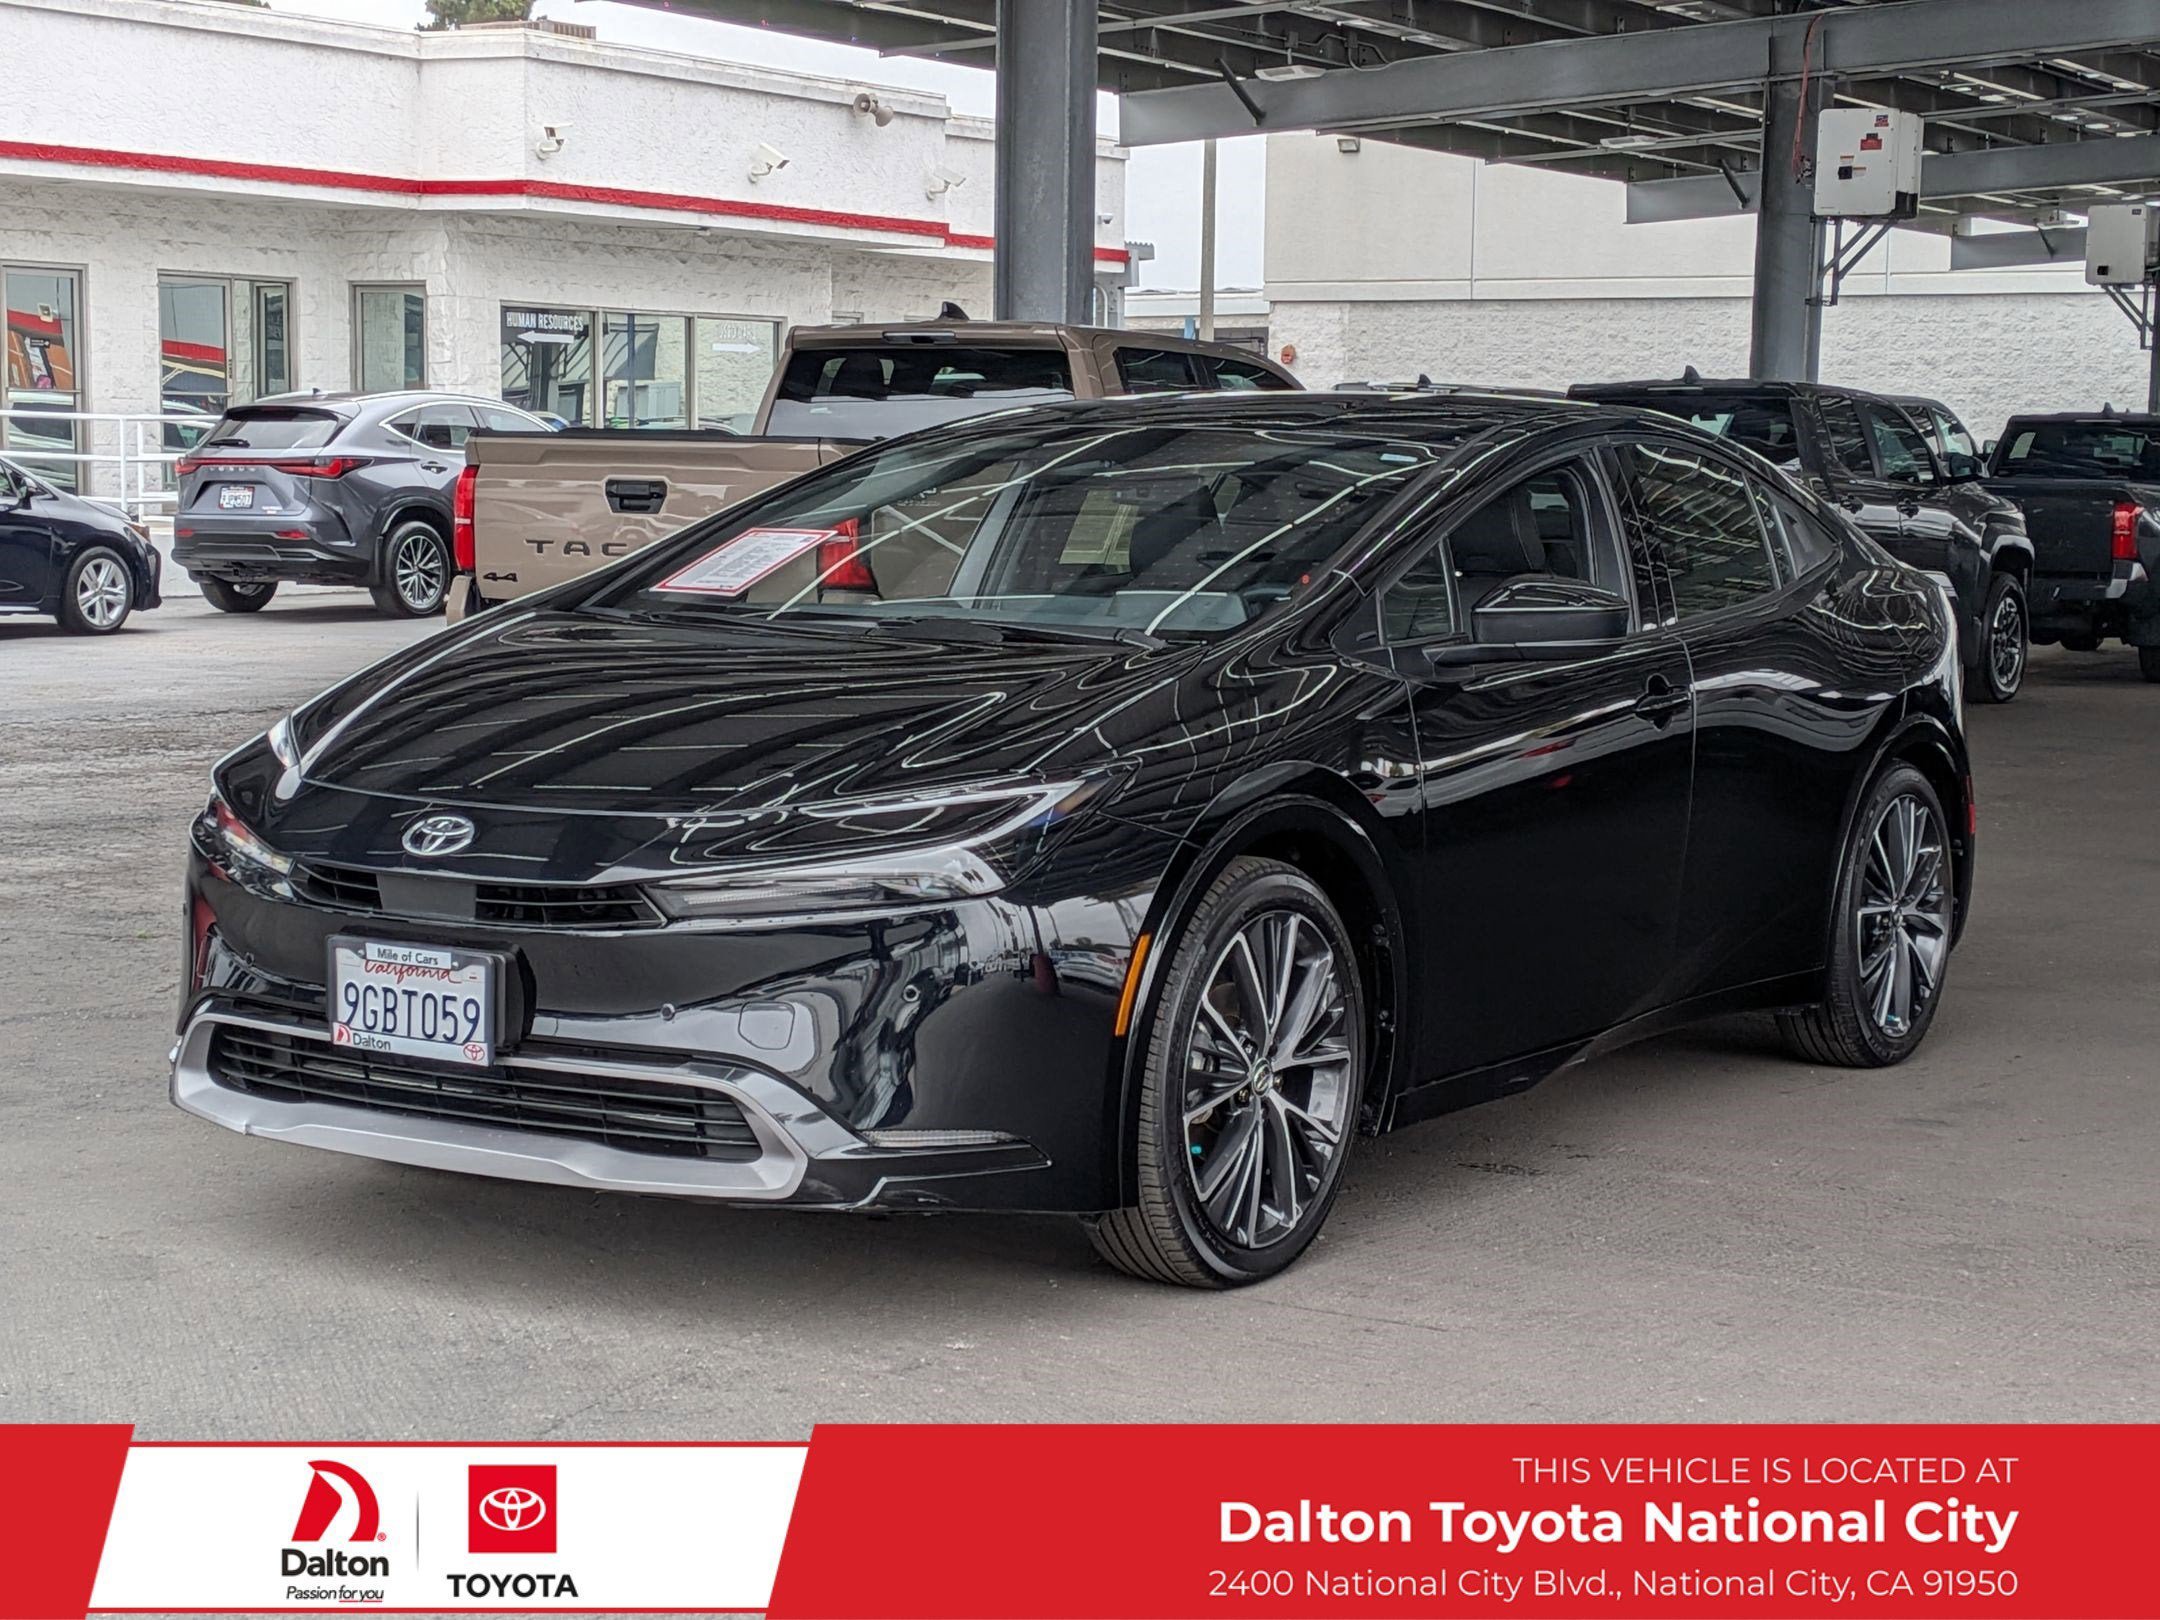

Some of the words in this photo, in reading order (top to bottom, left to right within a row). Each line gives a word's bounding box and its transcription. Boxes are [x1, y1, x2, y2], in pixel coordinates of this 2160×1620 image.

[506, 311, 537, 328] HUMAN
[538, 313, 584, 332] RESOURCES
[377, 947, 398, 959] Mile
[402, 951, 412, 962] of
[416, 953, 438, 965] Cars
[344, 981, 480, 1045] 9GBT059
[353, 1033, 391, 1050] Dalton
